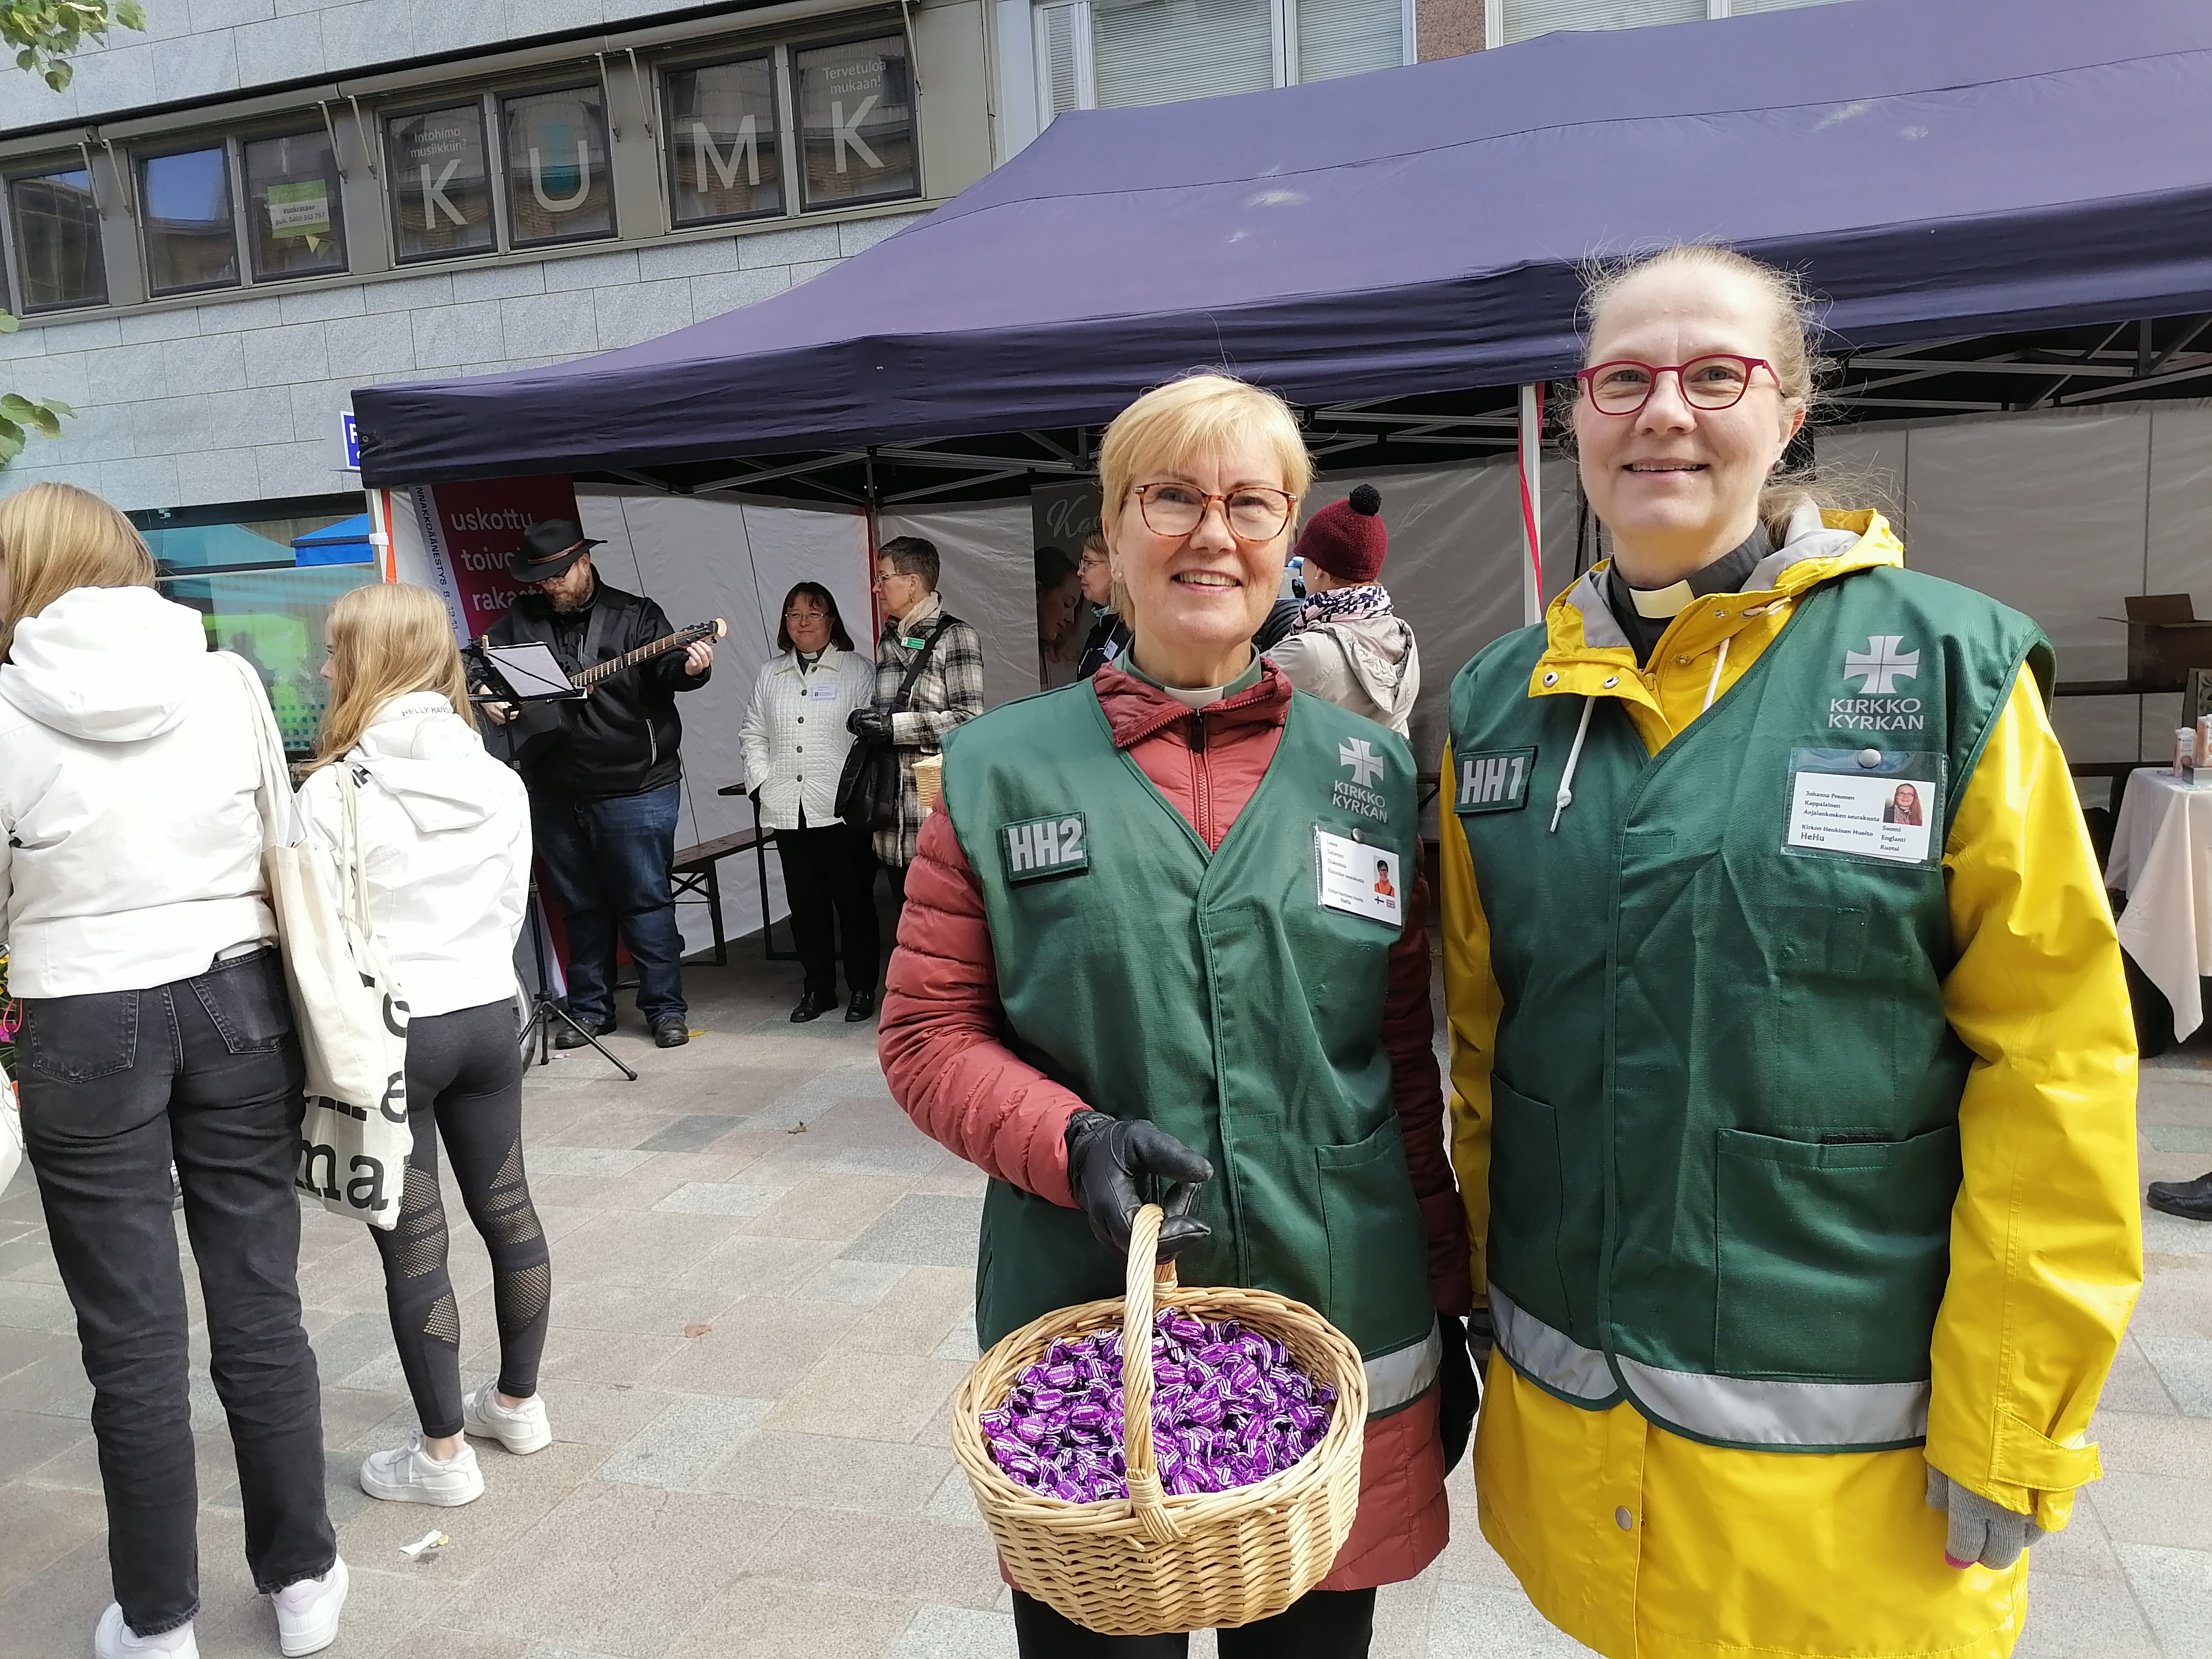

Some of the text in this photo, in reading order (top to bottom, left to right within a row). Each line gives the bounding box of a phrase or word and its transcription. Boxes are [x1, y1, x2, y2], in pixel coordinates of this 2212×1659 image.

[822, 59, 887, 80] Tervetuloa
[830, 75, 881, 95] mukaan!
[414, 127, 461, 143] Intohimo
[410, 138, 467, 158] musiikkiin?
[420, 95, 886, 230] K U M K
[401, 707, 429, 717] HELLY
[1830, 697, 1921, 714] KIRKKO
[1828, 713, 1924, 731] KYRKAN
[1460, 756, 1525, 804] HH1
[1334, 780, 1386, 808] KIRKKO
[1332, 793, 1389, 823] KYRKAN
[1008, 817, 1083, 872] HH2
[1801, 832, 1825, 842] HeHu
